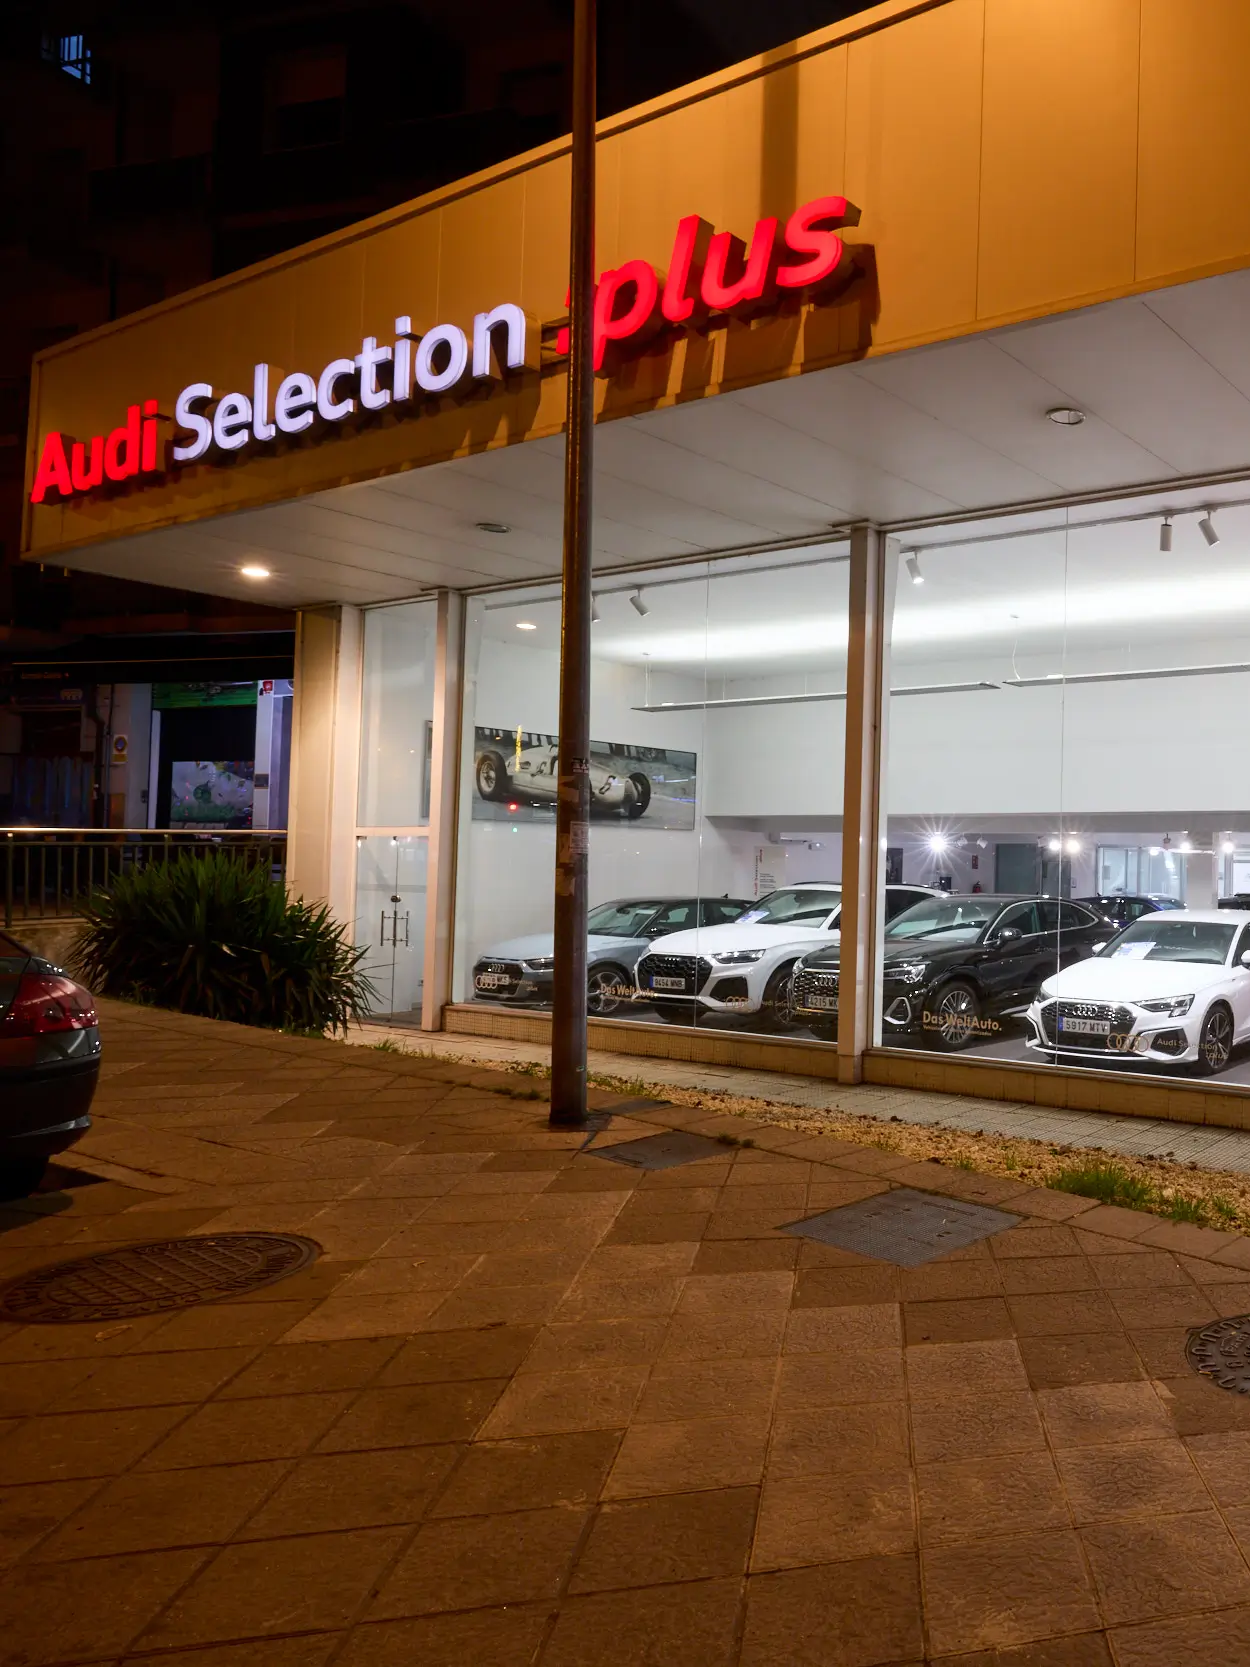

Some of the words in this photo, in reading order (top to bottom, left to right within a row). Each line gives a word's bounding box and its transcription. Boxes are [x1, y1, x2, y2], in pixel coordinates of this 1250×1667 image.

[31, 399, 160, 504] Audi
[173, 303, 534, 462] Selection
[922, 1010, 944, 1025] Das
[945, 1013, 1003, 1031] WeltAuto.
[1065, 1019, 1087, 1032] 5917
[1088, 1021, 1107, 1033] MTV
[1156, 1038, 1177, 1047] Audi
